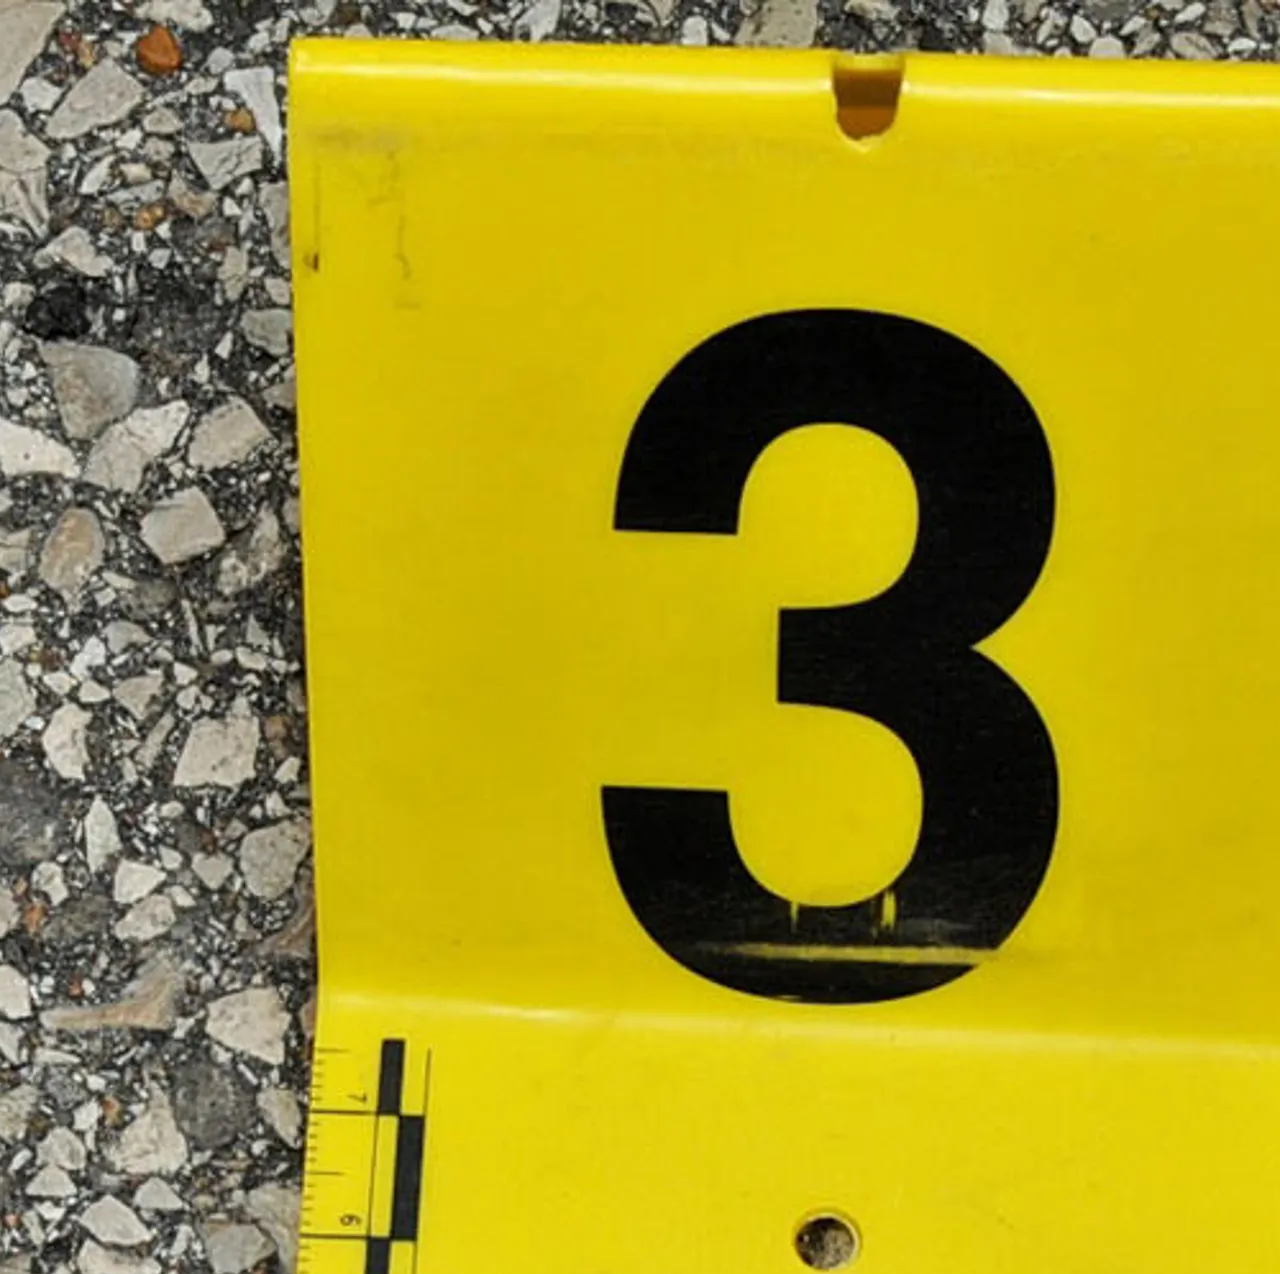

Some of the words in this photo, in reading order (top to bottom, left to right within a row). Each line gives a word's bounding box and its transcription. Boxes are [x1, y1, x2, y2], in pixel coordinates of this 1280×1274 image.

[600, 307, 1060, 1006] 3
[348, 1093, 367, 1103] 7
[339, 1214, 362, 1227] 6
